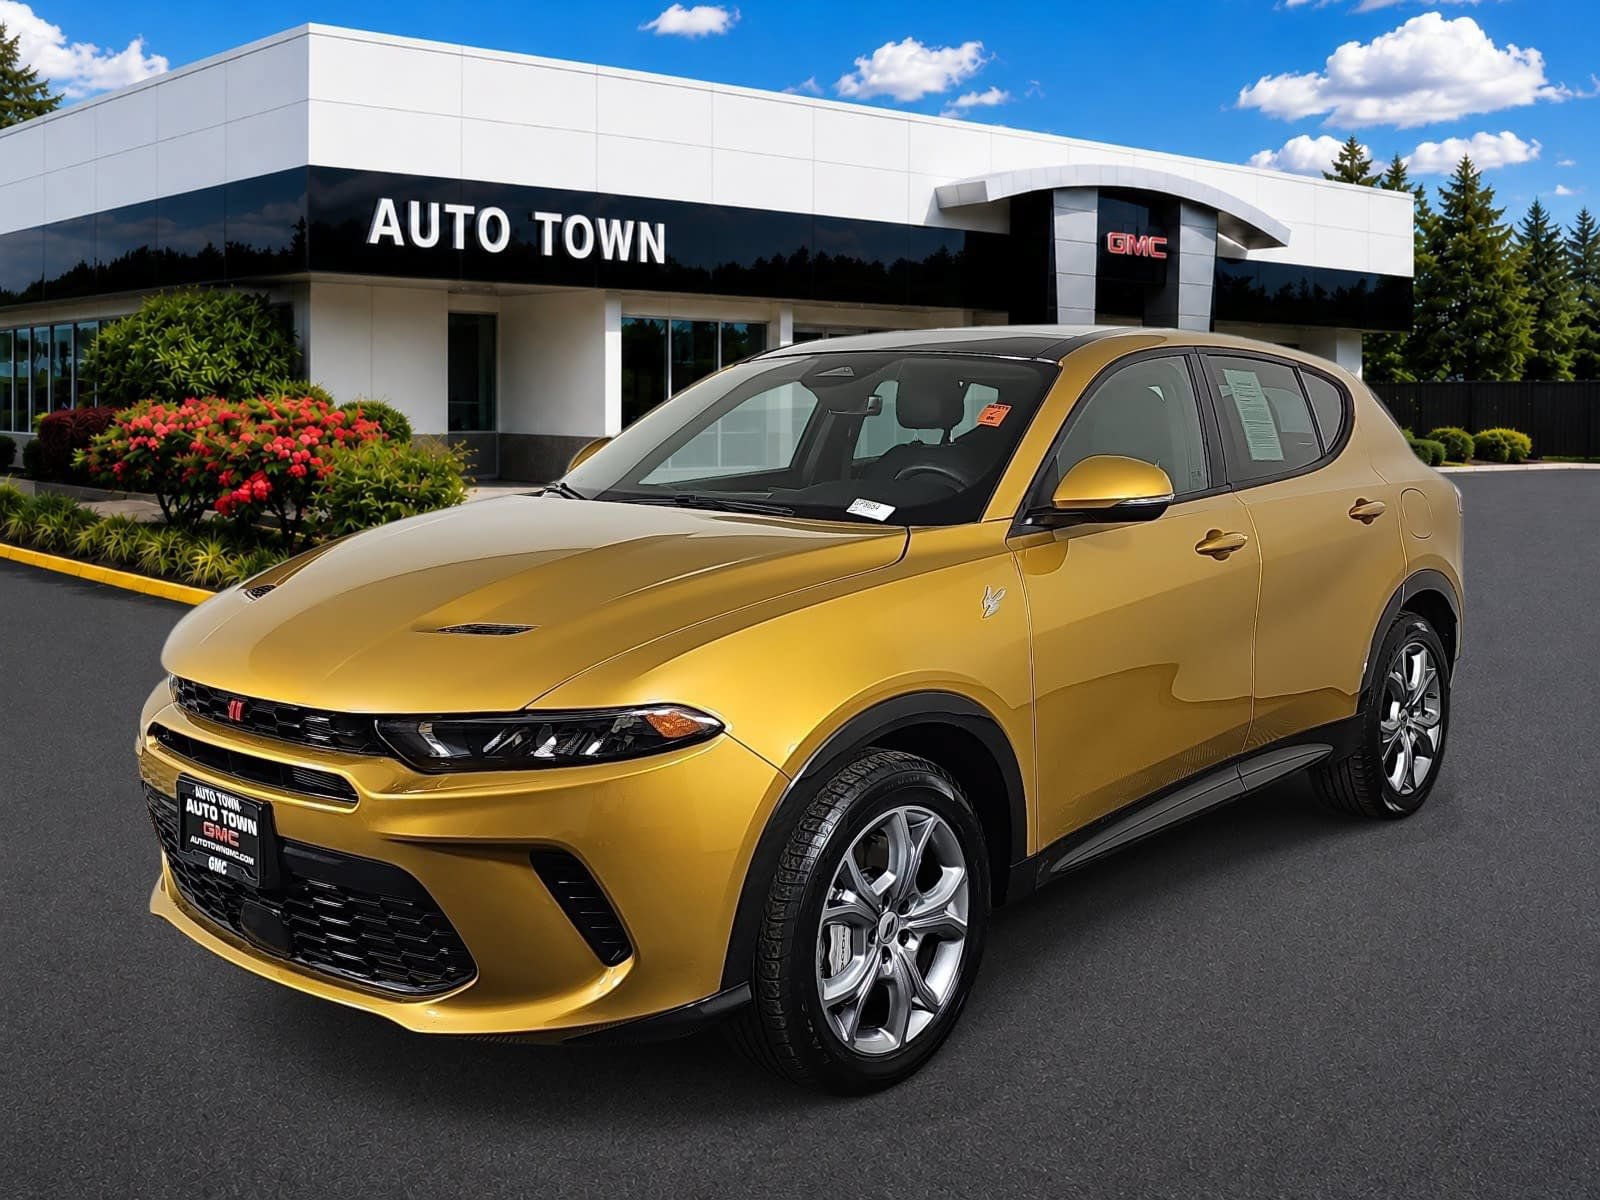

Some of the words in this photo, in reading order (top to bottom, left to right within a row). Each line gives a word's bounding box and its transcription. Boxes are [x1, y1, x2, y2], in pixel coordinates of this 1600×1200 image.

[366, 197, 511, 254] AUTO
[531, 210, 666, 265] TOWN
[1107, 231, 1168, 259] GMC
[195, 785, 216, 804] AUTO
[217, 792, 241, 812] TOWN
[186, 798, 218, 821] AUTO
[221, 809, 257, 836] TOWN
[203, 821, 239, 847] GMC
[190, 835, 254, 865] AUTOTOWNGMC.COM
[208, 856, 227, 875] GMC
